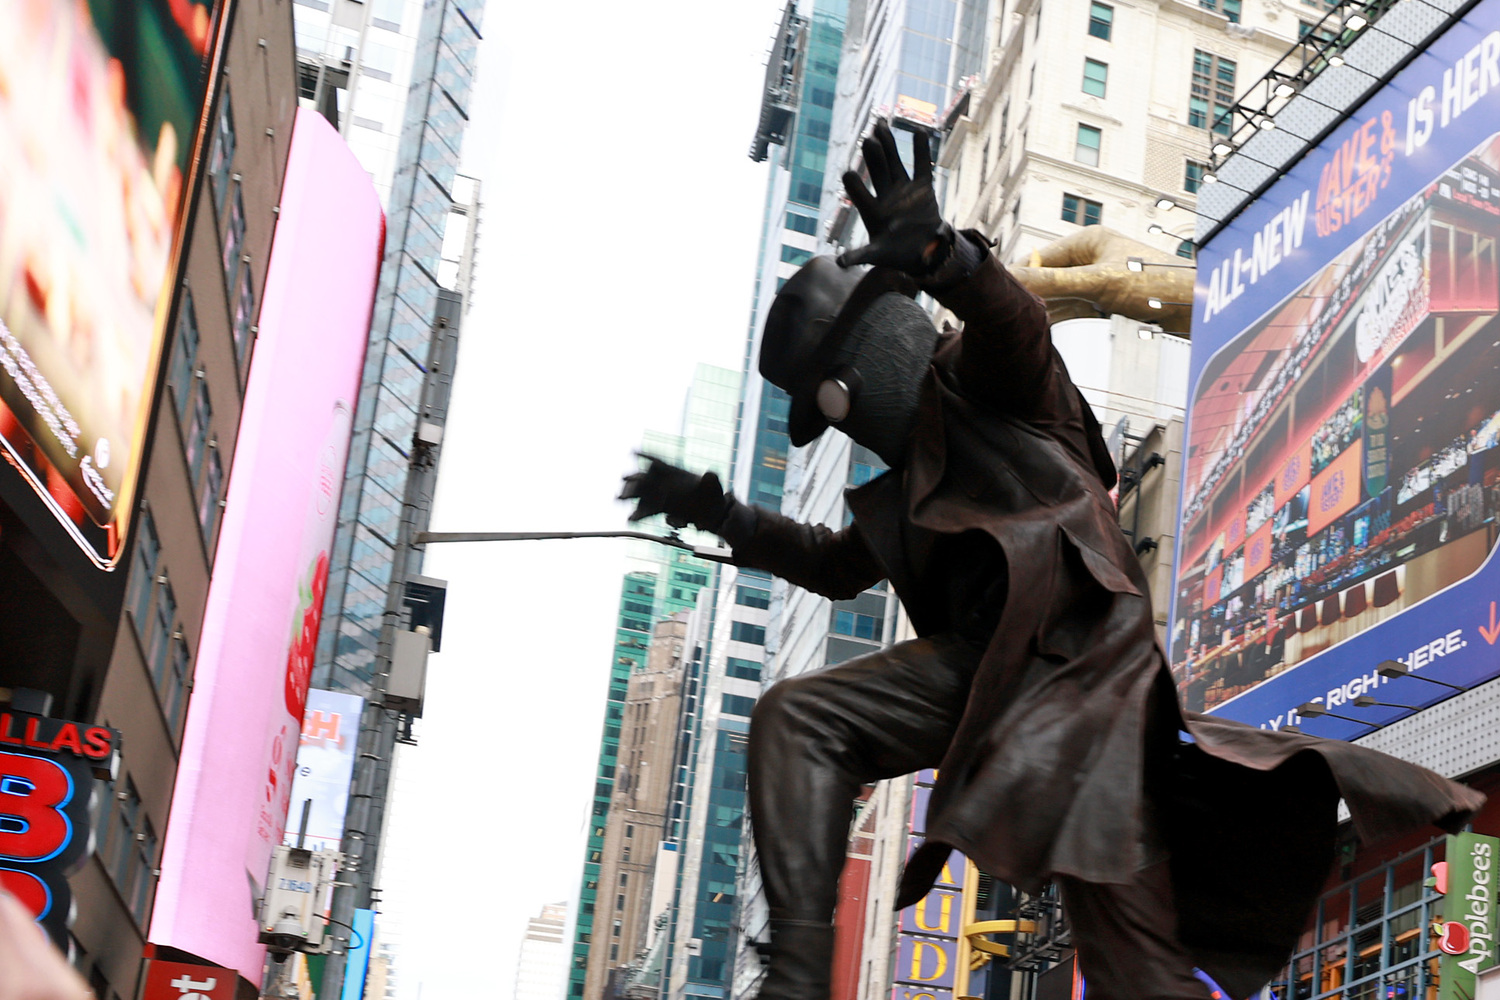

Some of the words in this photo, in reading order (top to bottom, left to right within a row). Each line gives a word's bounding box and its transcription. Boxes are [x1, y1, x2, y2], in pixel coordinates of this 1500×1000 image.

[1405, 86, 1435, 157] IS
[1203, 190, 1310, 322] ALL-NEW
[0, 713, 112, 758] LLAS
[1457, 842, 1493, 976] Applebee's
